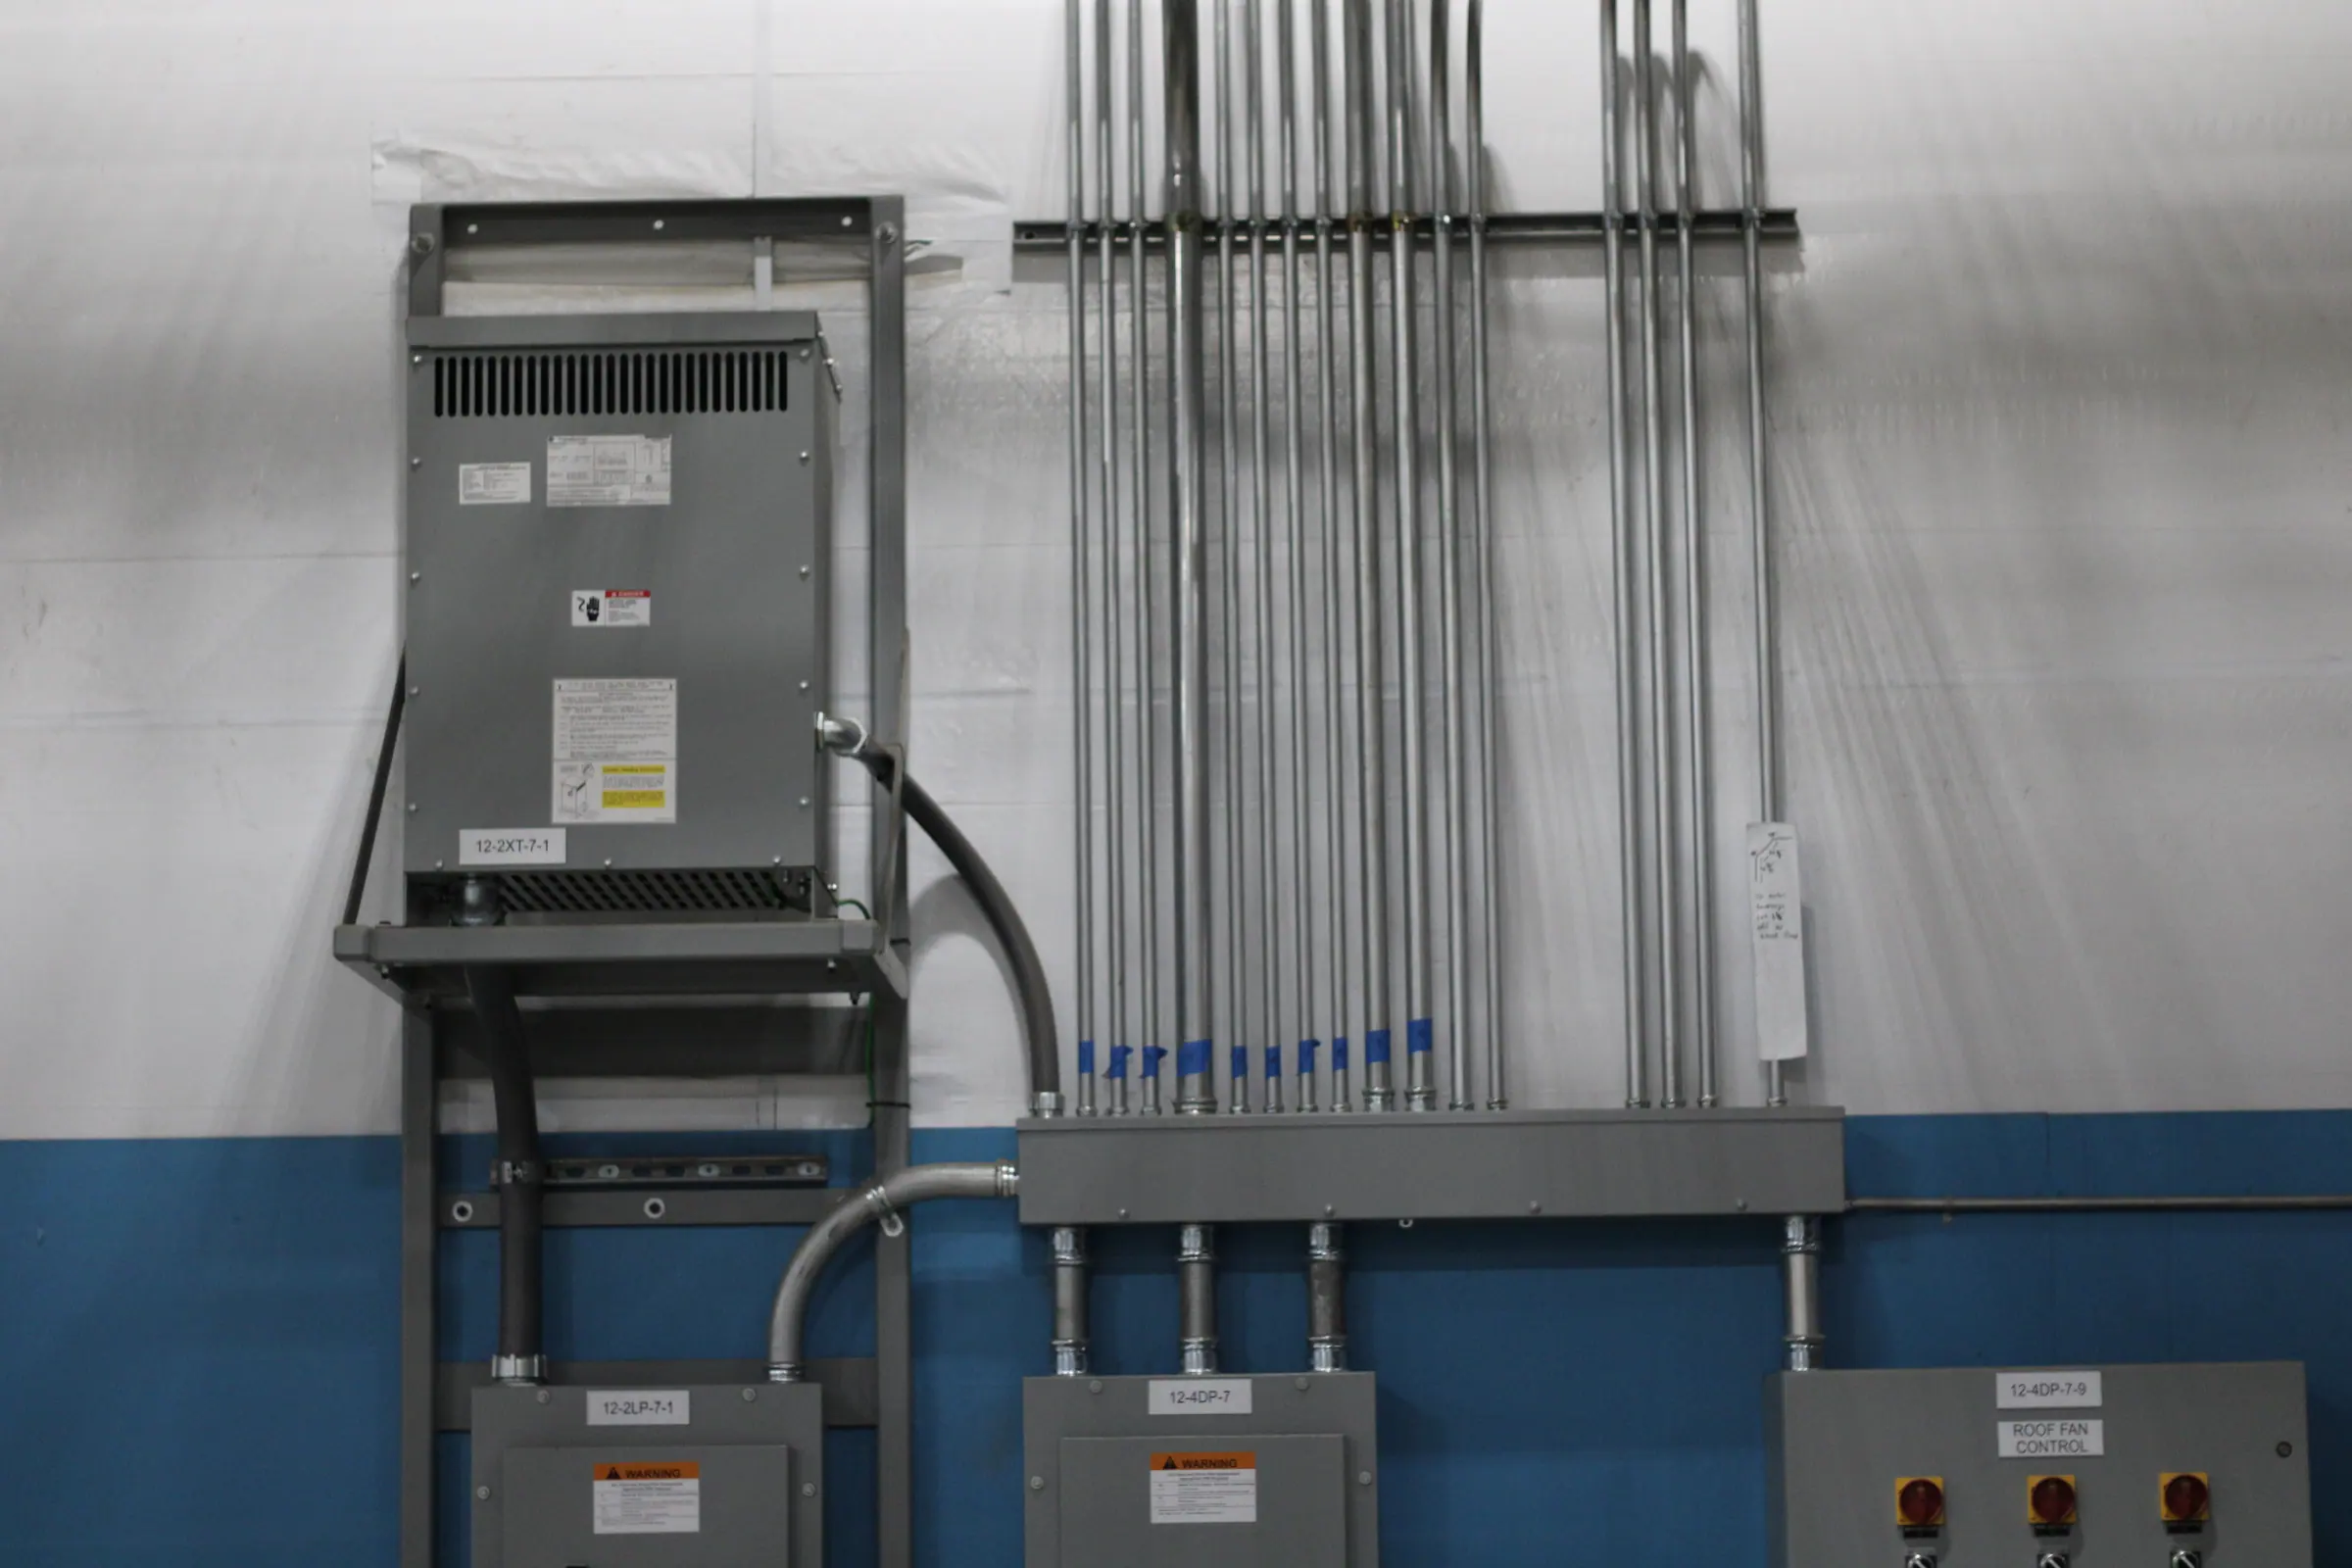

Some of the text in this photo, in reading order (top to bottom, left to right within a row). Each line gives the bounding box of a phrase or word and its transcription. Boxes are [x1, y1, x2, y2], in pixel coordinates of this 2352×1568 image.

[475, 839, 550, 854] 12-2XT-7-1
[1169, 1390, 1231, 1403] 12-4DP-7
[2010, 1382, 2086, 1397] 12-4DP-7-9
[603, 1400, 674, 1415] 12-2LP-7-1
[2013, 1422, 2088, 1437] ROOF FAN
[2016, 1439, 2089, 1453] CONTROL
[1181, 1458, 1237, 1468] WARNING
[624, 1468, 681, 1478] WARNING
